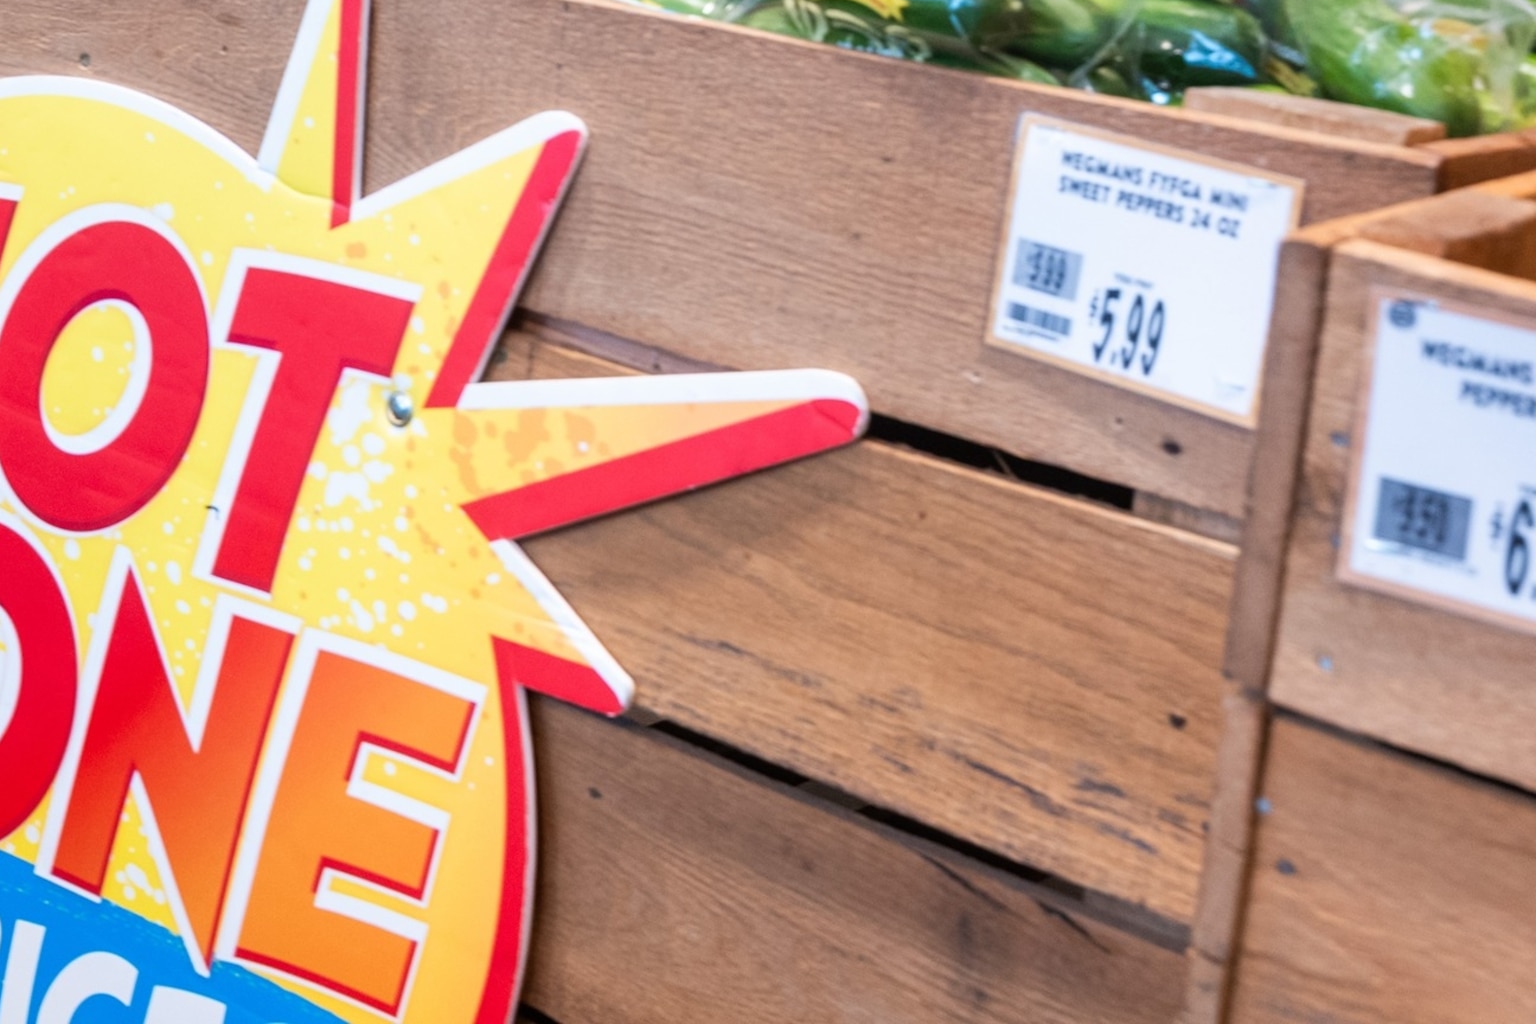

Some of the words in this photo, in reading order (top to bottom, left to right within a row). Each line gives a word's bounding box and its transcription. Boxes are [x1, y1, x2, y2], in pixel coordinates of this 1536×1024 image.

[1058, 176, 1111, 202] SWEET
[1116, 190, 1183, 223] PEPPERS
[1190, 209, 1211, 230] 24
[1217, 215, 1241, 238] OZ
[1061, 152, 1143, 187] WEGMANS
[1149, 171, 1201, 200] FYFGA
[1210, 187, 1248, 212] MINI
[1089, 287, 1165, 375] $5.99
[1420, 340, 1533, 385] WEGMANS
